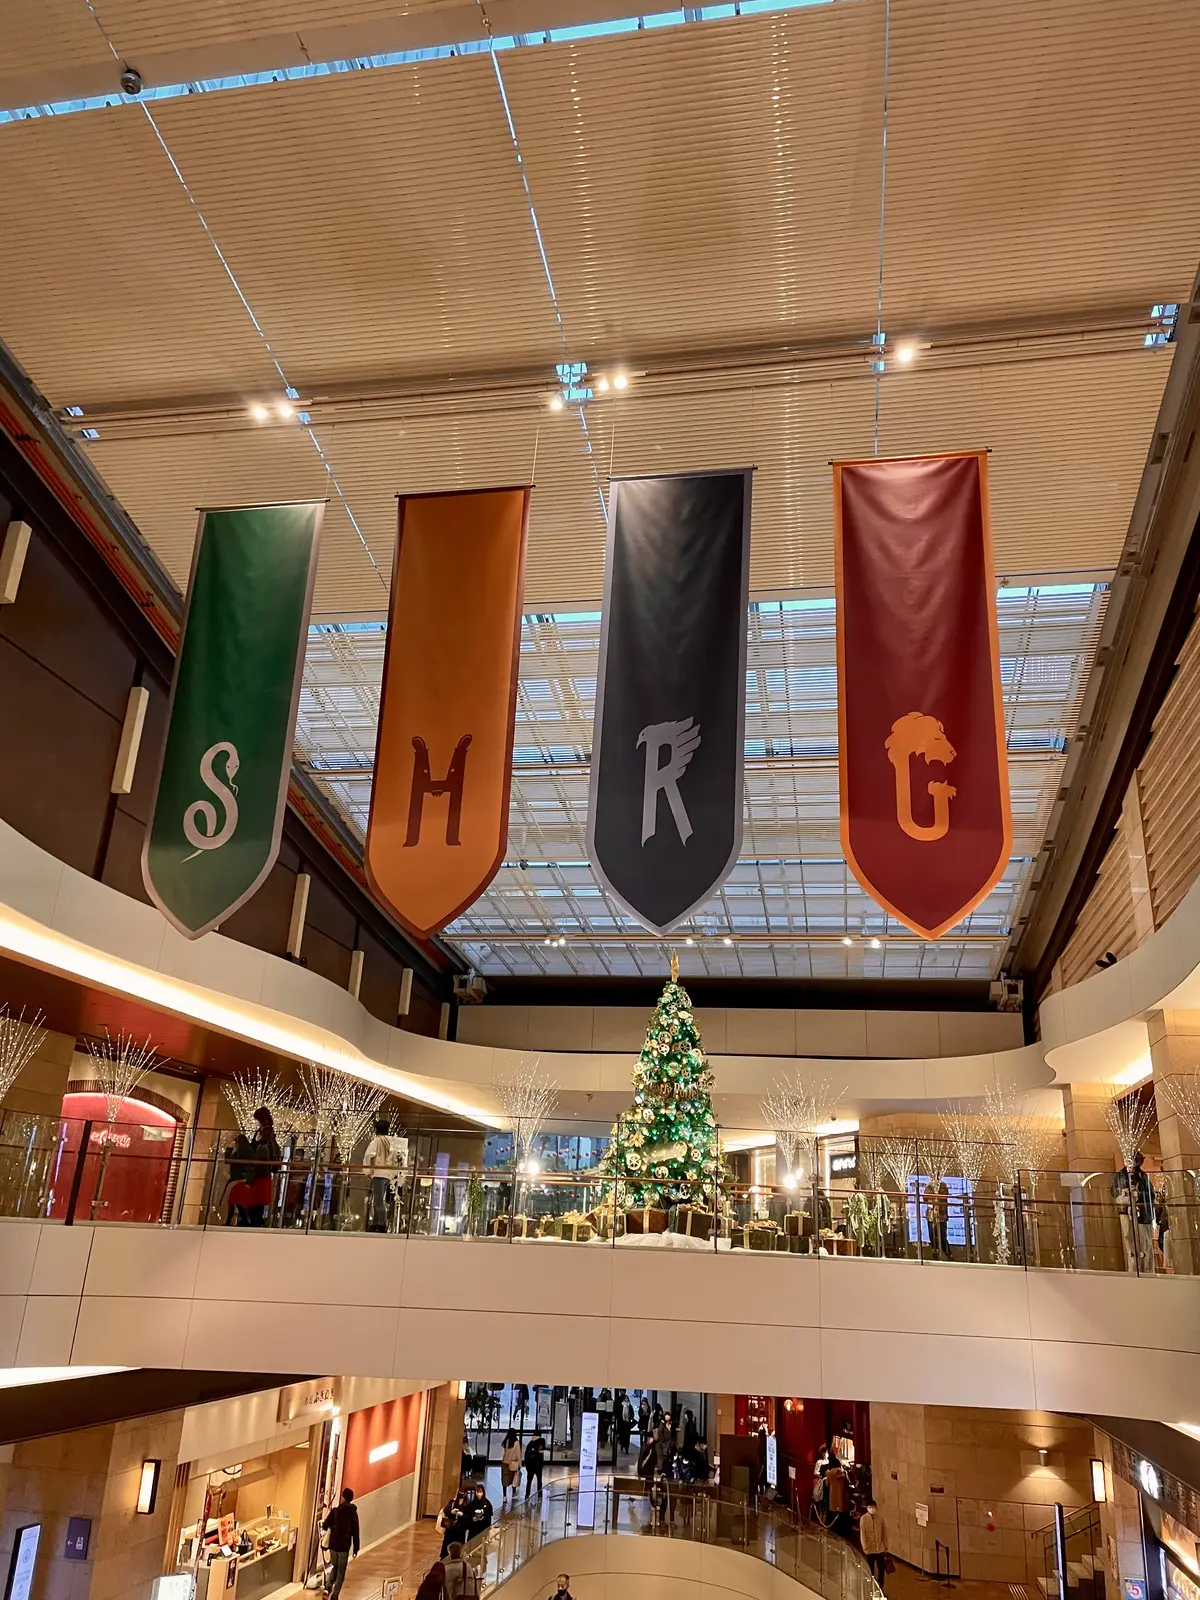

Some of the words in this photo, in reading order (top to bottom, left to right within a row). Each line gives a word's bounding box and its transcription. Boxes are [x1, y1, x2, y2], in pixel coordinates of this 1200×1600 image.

[181, 741, 240, 863] S
[402, 733, 473, 847] H
[635, 716, 701, 848] R
[884, 711, 957, 842] G
